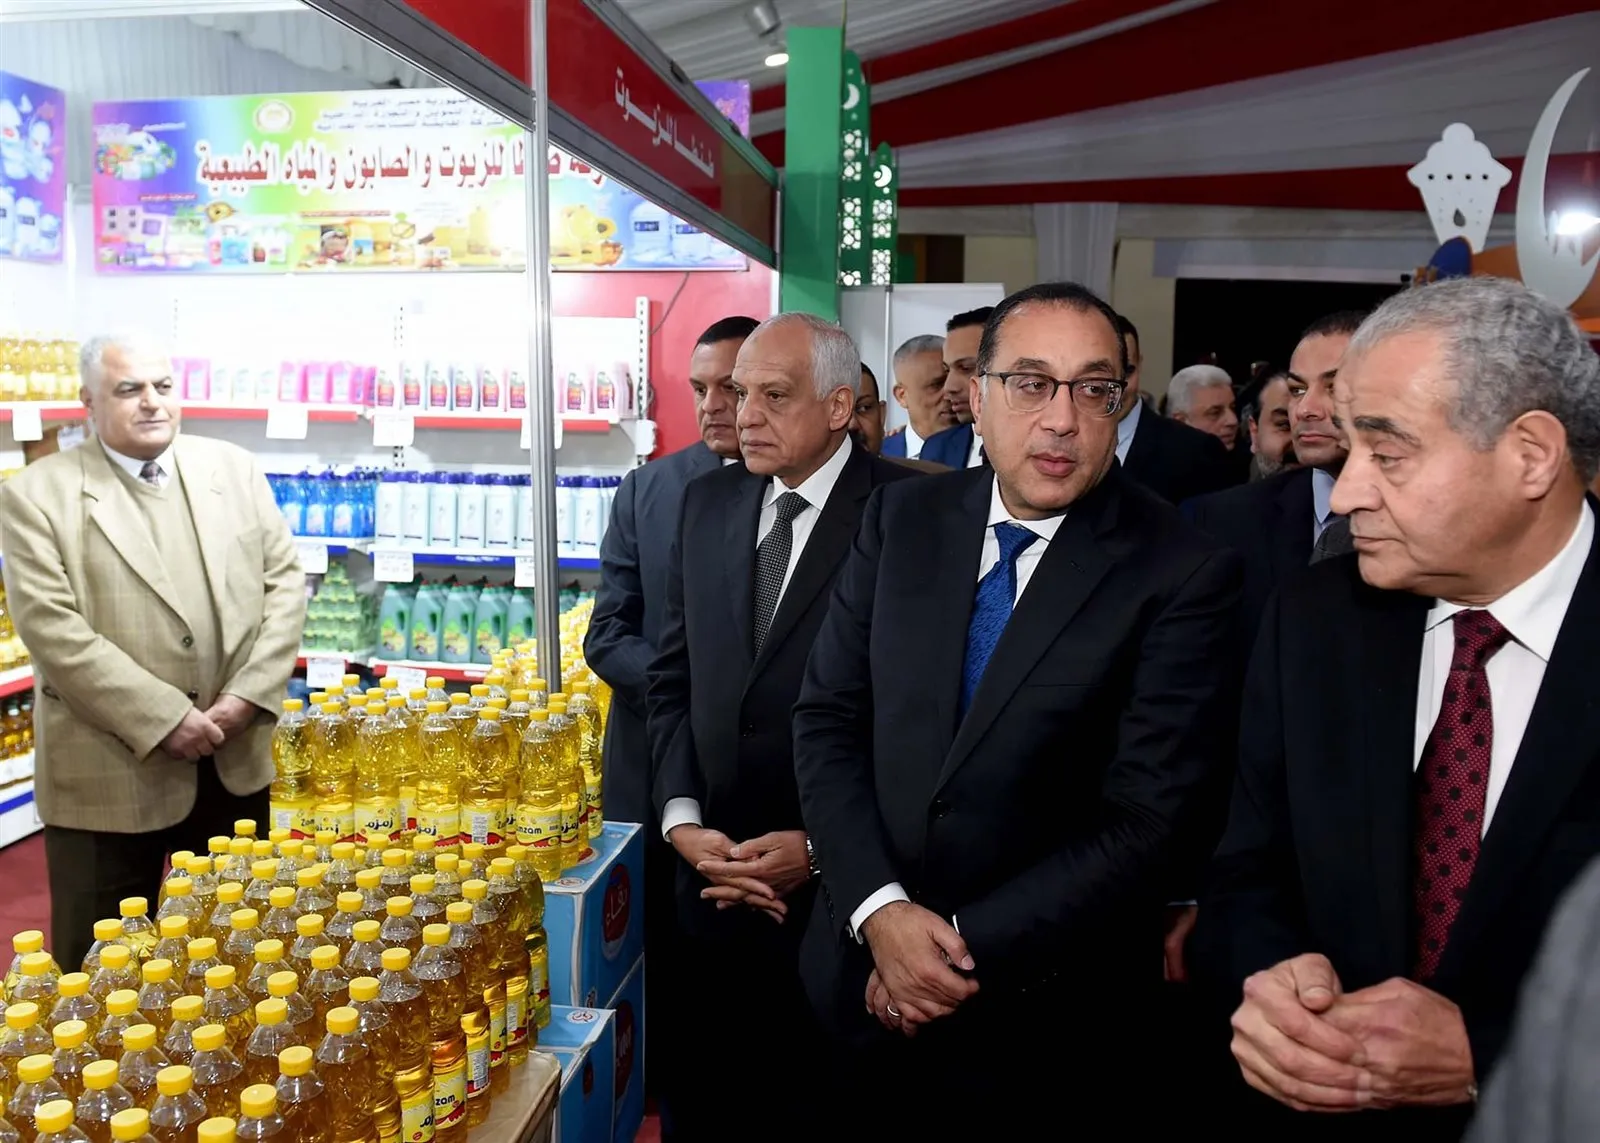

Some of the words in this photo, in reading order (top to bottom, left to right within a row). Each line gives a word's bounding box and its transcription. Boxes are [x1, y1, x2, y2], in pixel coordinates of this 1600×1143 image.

[615, 66, 674, 147] للزيوت
[200, 146, 276, 192] الطبيعية
[439, 142, 504, 187] للزيوت
[435, 1094, 456, 1106] zam
